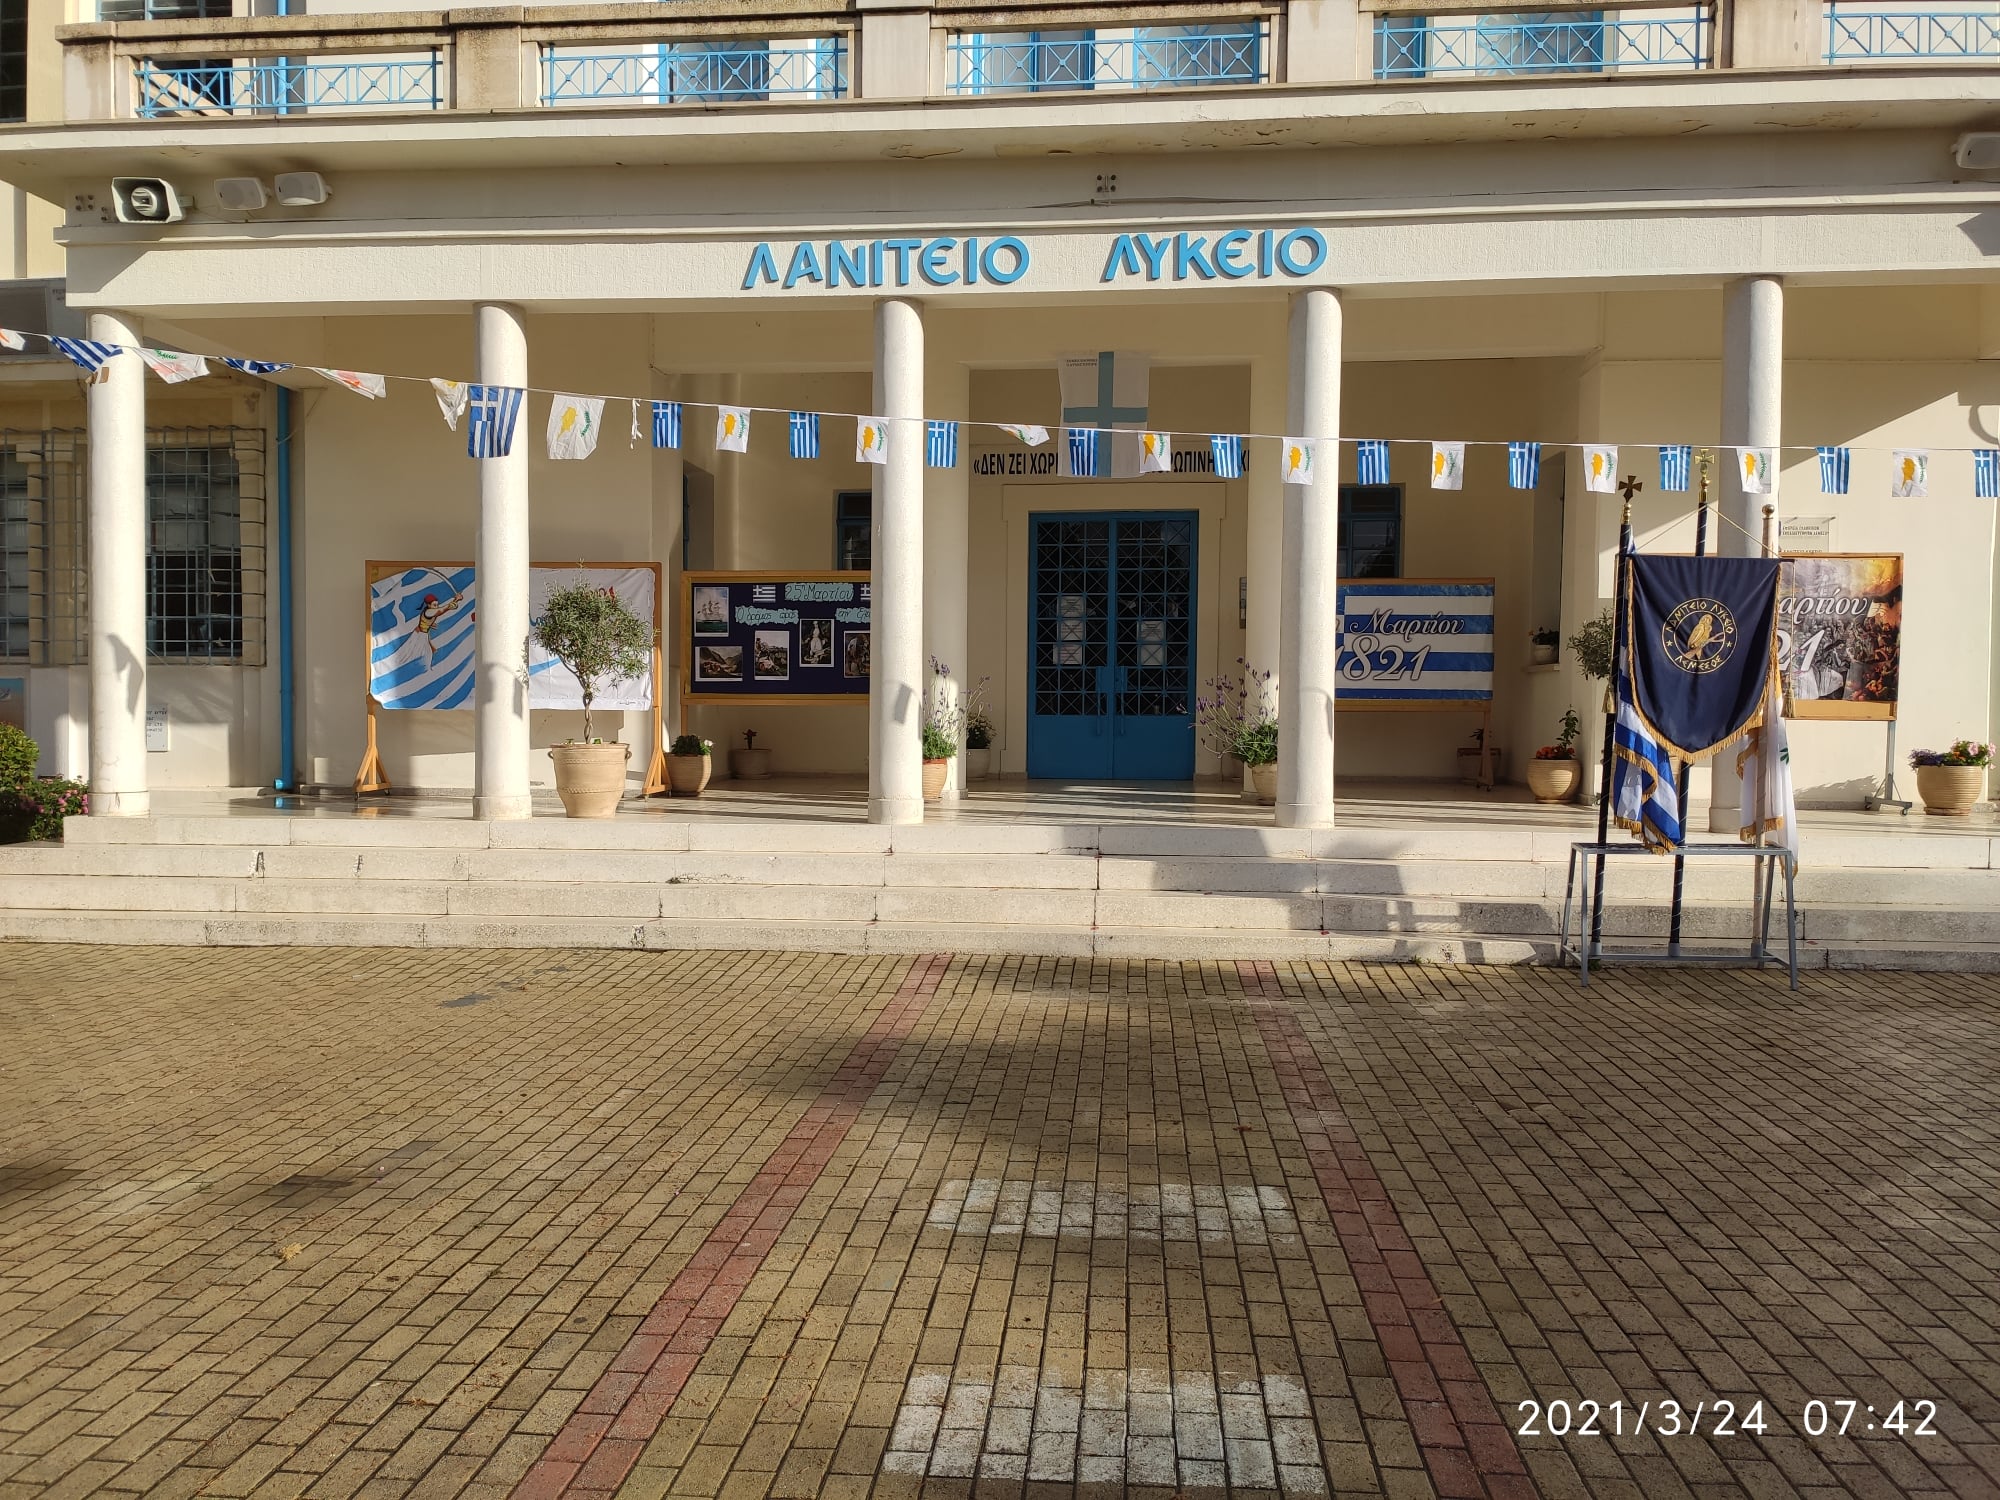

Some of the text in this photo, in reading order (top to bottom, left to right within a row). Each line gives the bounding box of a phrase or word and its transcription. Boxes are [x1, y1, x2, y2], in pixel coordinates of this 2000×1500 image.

[742, 227, 1328, 289] ΛΑΝΙΤΕΙΟ ΛΥΚΕΙΟ
[973, 453, 1005, 475] «ΔΕΝ
[1009, 453, 1026, 475] ΖΕΙ
[1030, 452, 1058, 474] ΧΩΡΙ
[1665, 601, 1734, 634] ΛΑΝΙΤΕΙΟ ΛΥΚΕΙΟ
[1778, 588, 1867, 624] αρτίου
[1350, 608, 1464, 642] Μαρτίου
